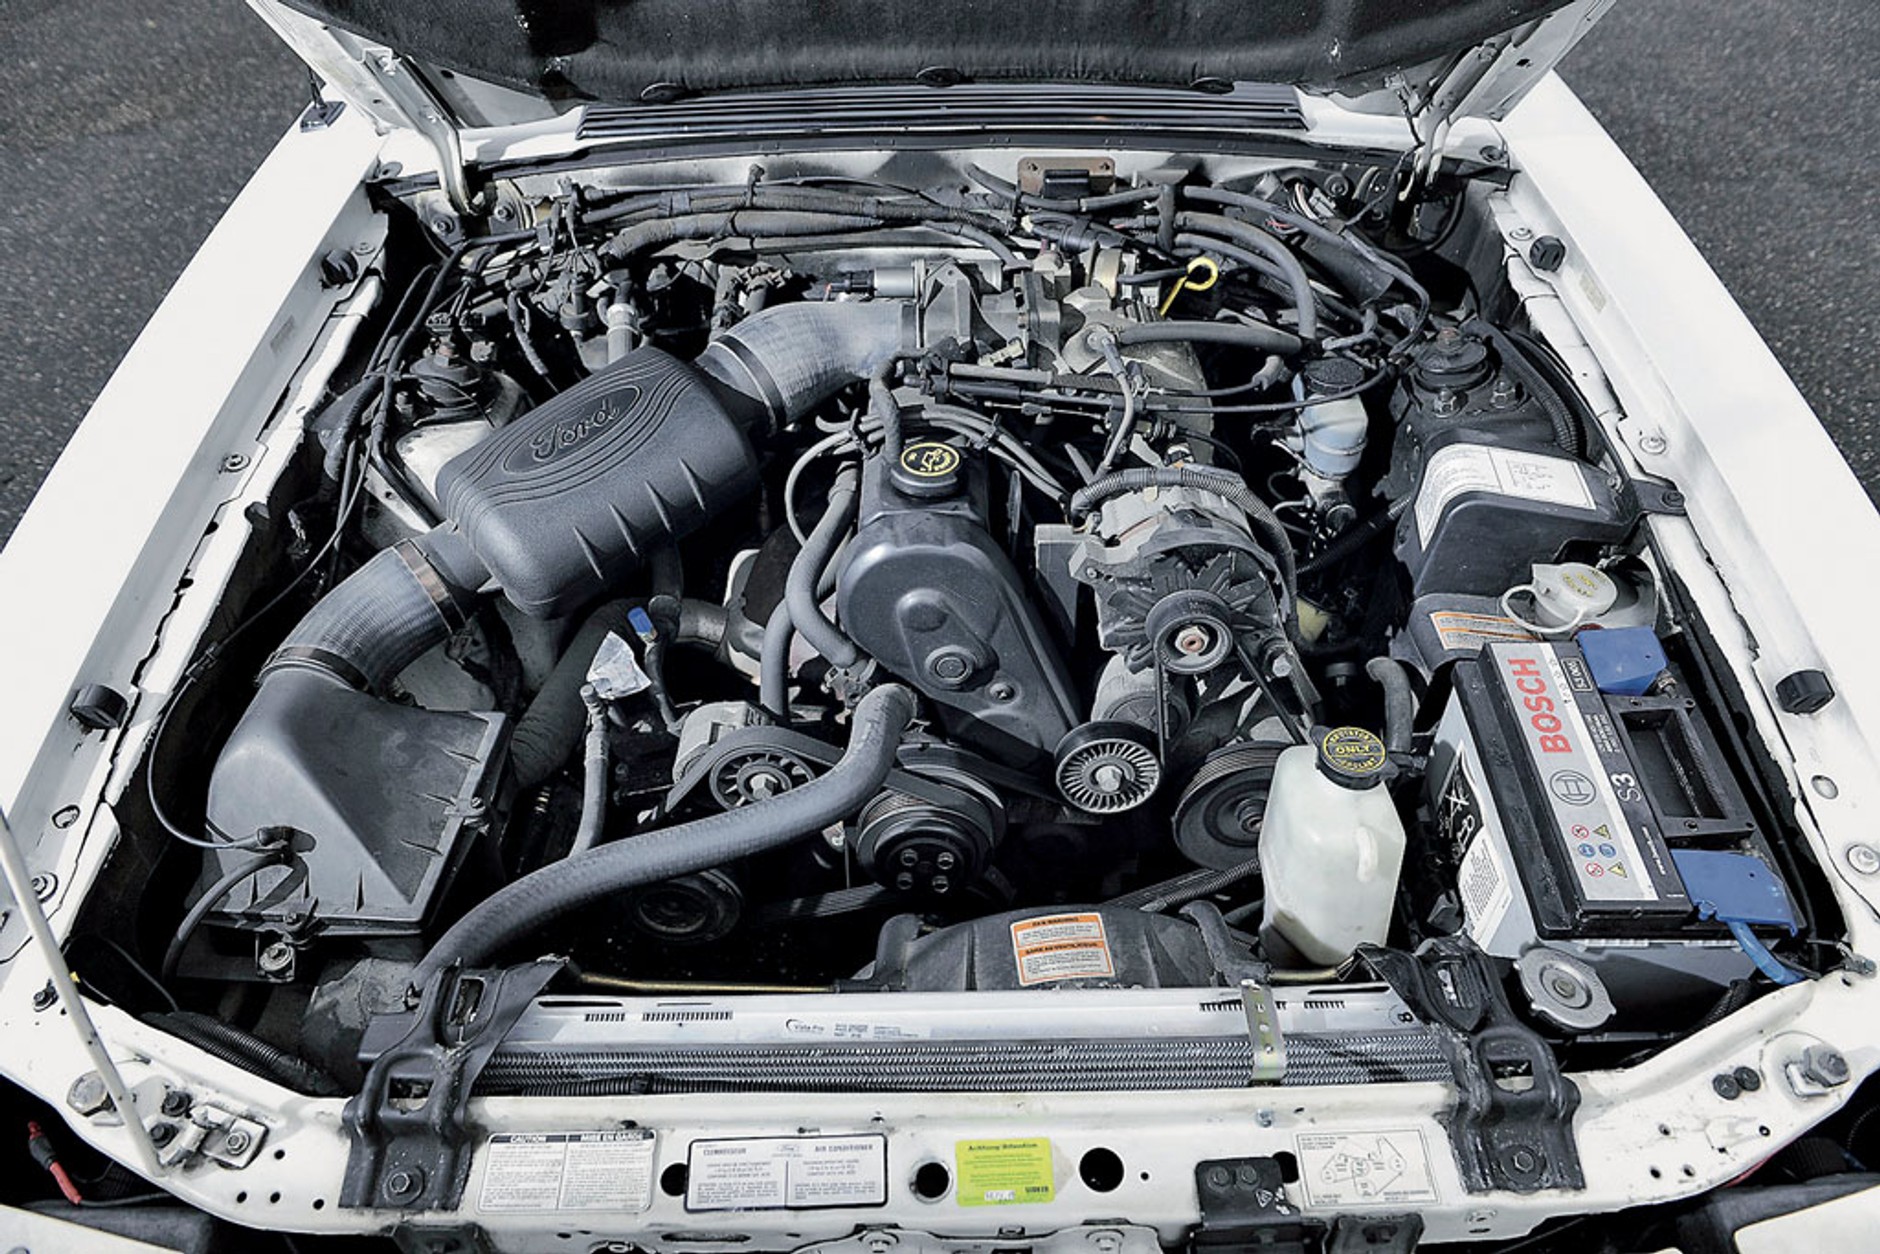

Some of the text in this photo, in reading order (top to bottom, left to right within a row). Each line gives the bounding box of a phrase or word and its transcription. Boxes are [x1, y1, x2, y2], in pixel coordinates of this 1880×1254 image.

[529, 397, 620, 462] Ford
[1508, 658, 1573, 753] BOSCH
[1335, 744, 1371, 755] ONLY
[1610, 772, 1642, 802] S3
[510, 1135, 547, 1143] CAUTION
[580, 1133, 600, 1142] MISE
[602, 1133, 614, 1142] EN
